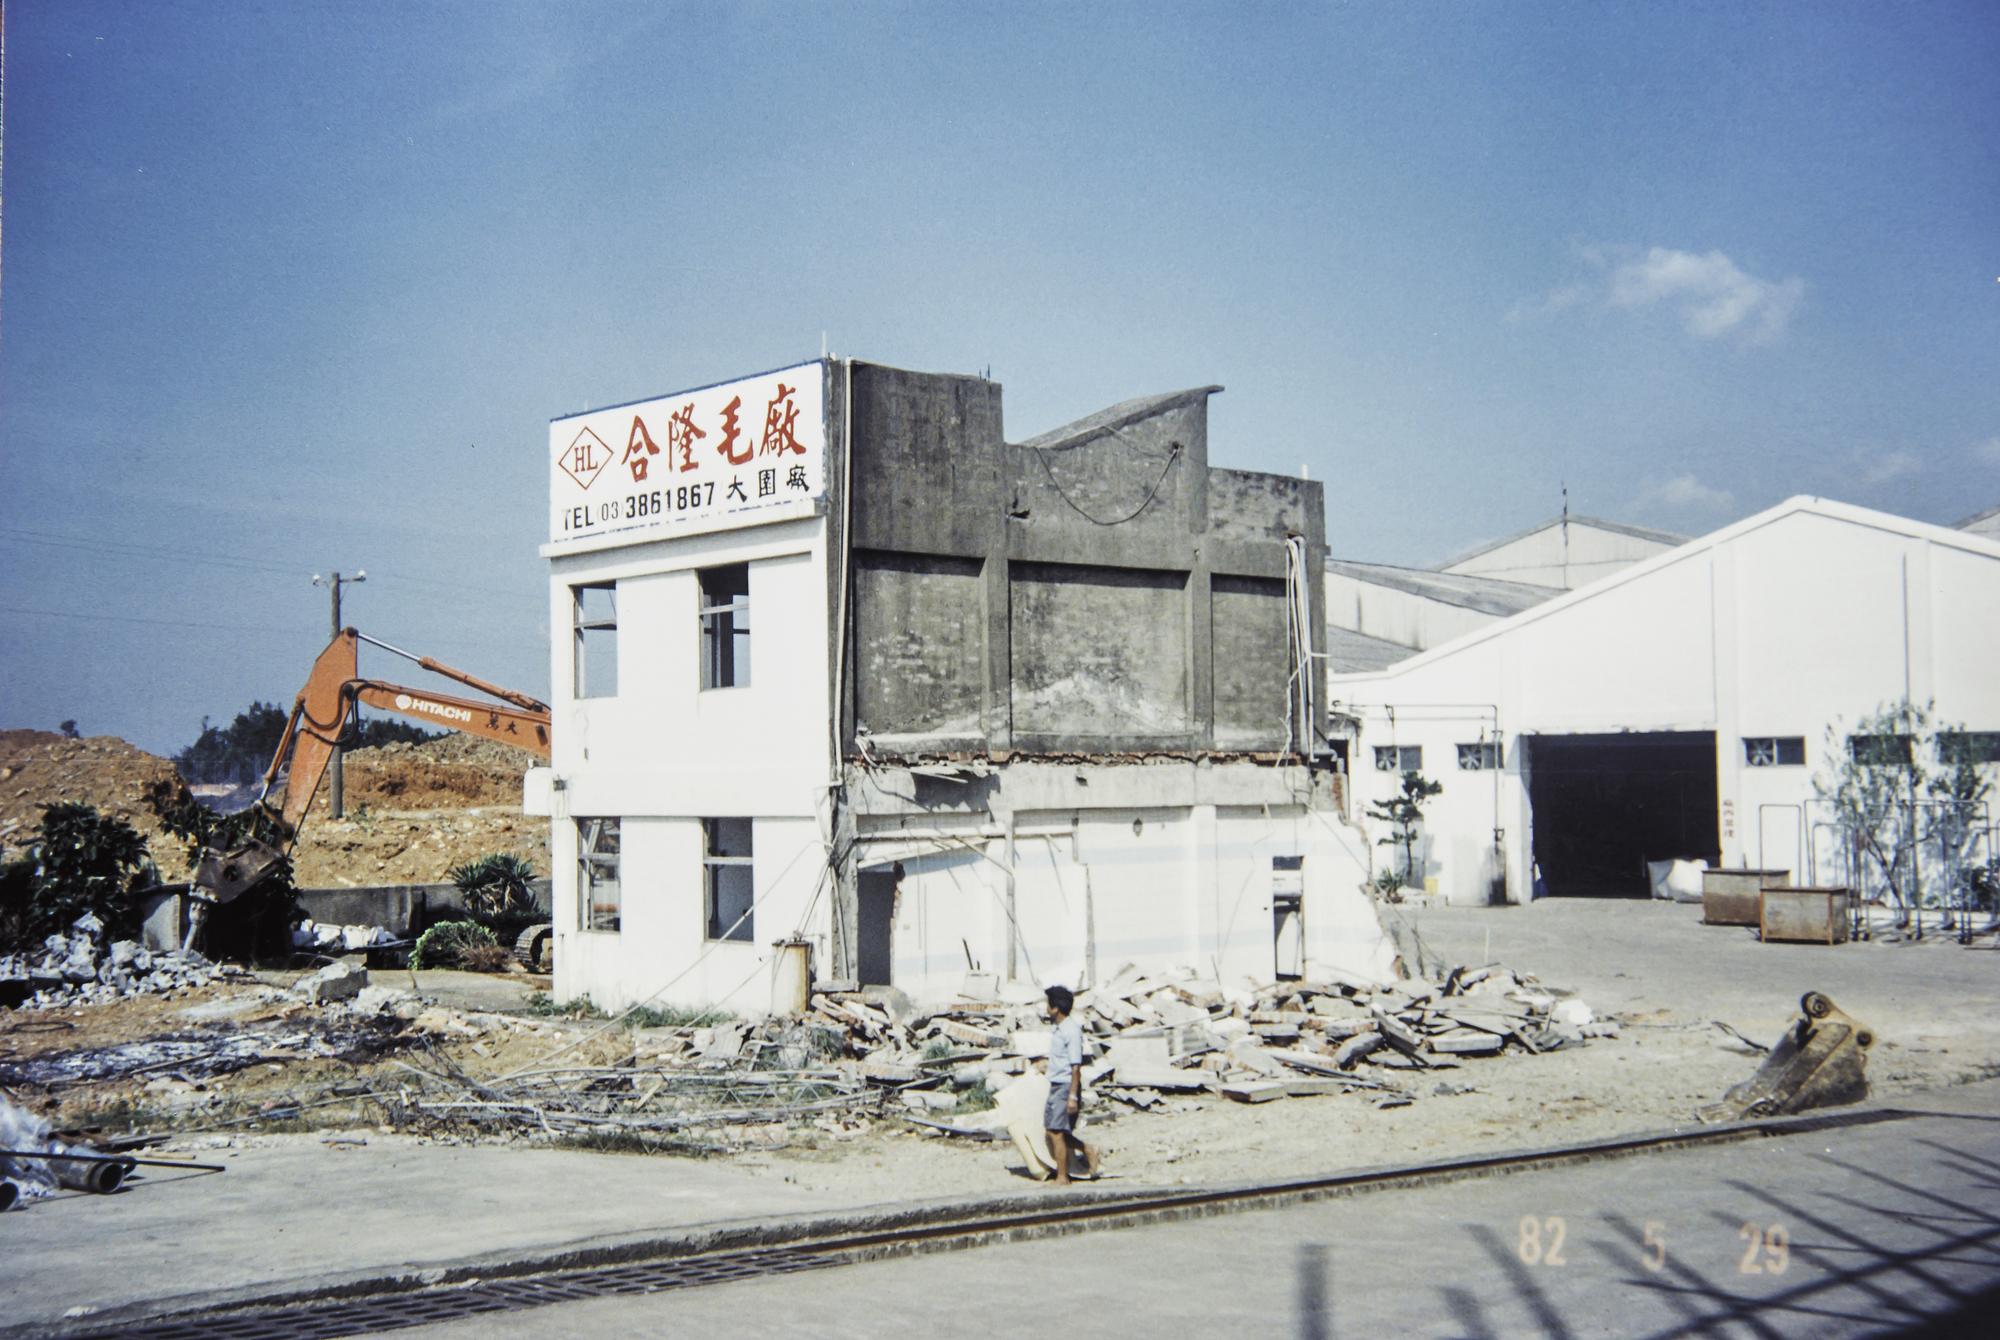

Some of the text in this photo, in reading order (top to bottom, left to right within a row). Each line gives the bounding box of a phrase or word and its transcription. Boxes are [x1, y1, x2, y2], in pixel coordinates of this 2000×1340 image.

[621, 383, 807, 483] 合隆毛廠
[573, 444, 599, 473] HL
[562, 505, 594, 531] TEL
[412, 699, 472, 723] HITACHI
